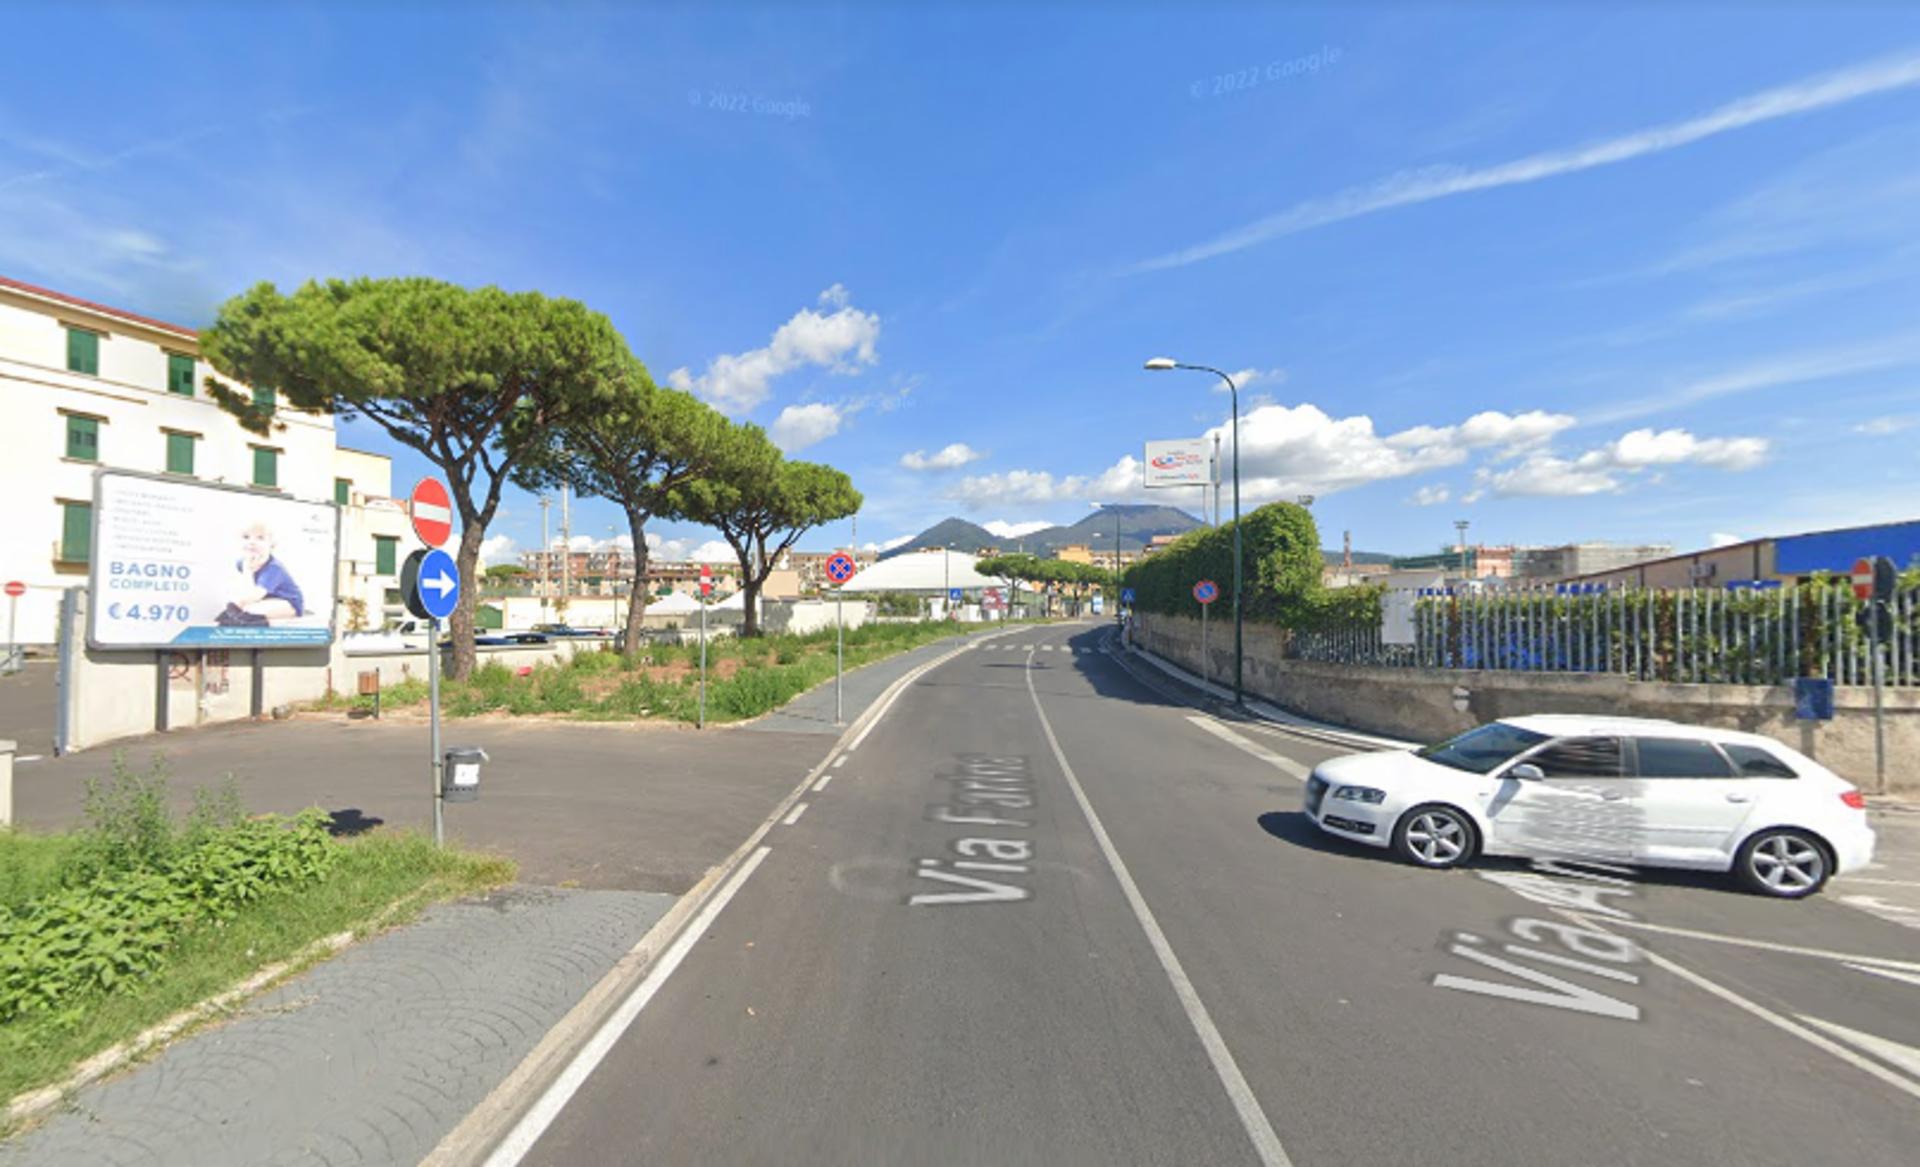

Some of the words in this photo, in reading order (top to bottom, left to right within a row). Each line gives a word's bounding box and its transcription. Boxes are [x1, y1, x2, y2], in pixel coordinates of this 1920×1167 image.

[109, 561, 191, 580] BAGNO
[109, 578, 191, 593] COMPLETO
[108, 602, 122, 622] €
[125, 604, 190, 623] 4.970
